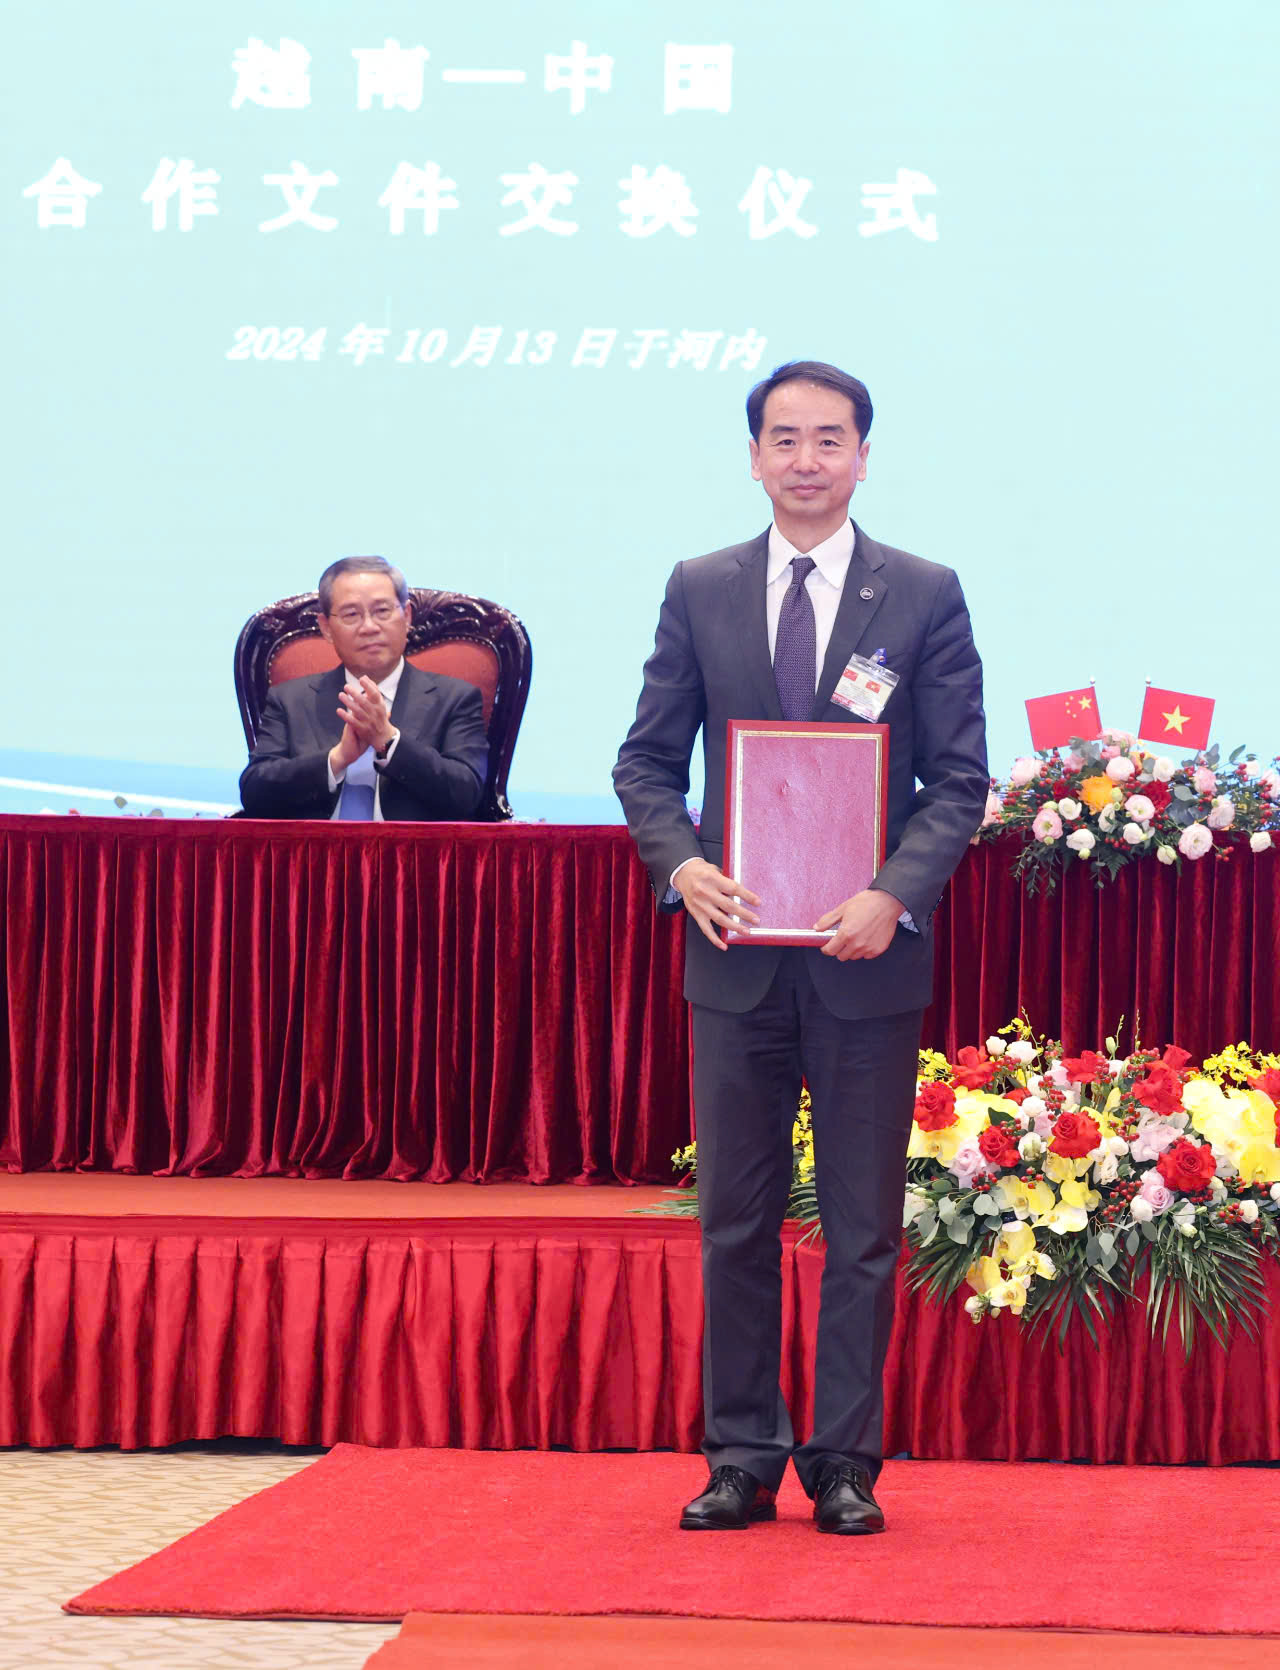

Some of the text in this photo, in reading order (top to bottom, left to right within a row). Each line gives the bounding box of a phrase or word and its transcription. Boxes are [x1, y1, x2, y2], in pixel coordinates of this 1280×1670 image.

[23, 156, 939, 242] 合作文件交换仪式
